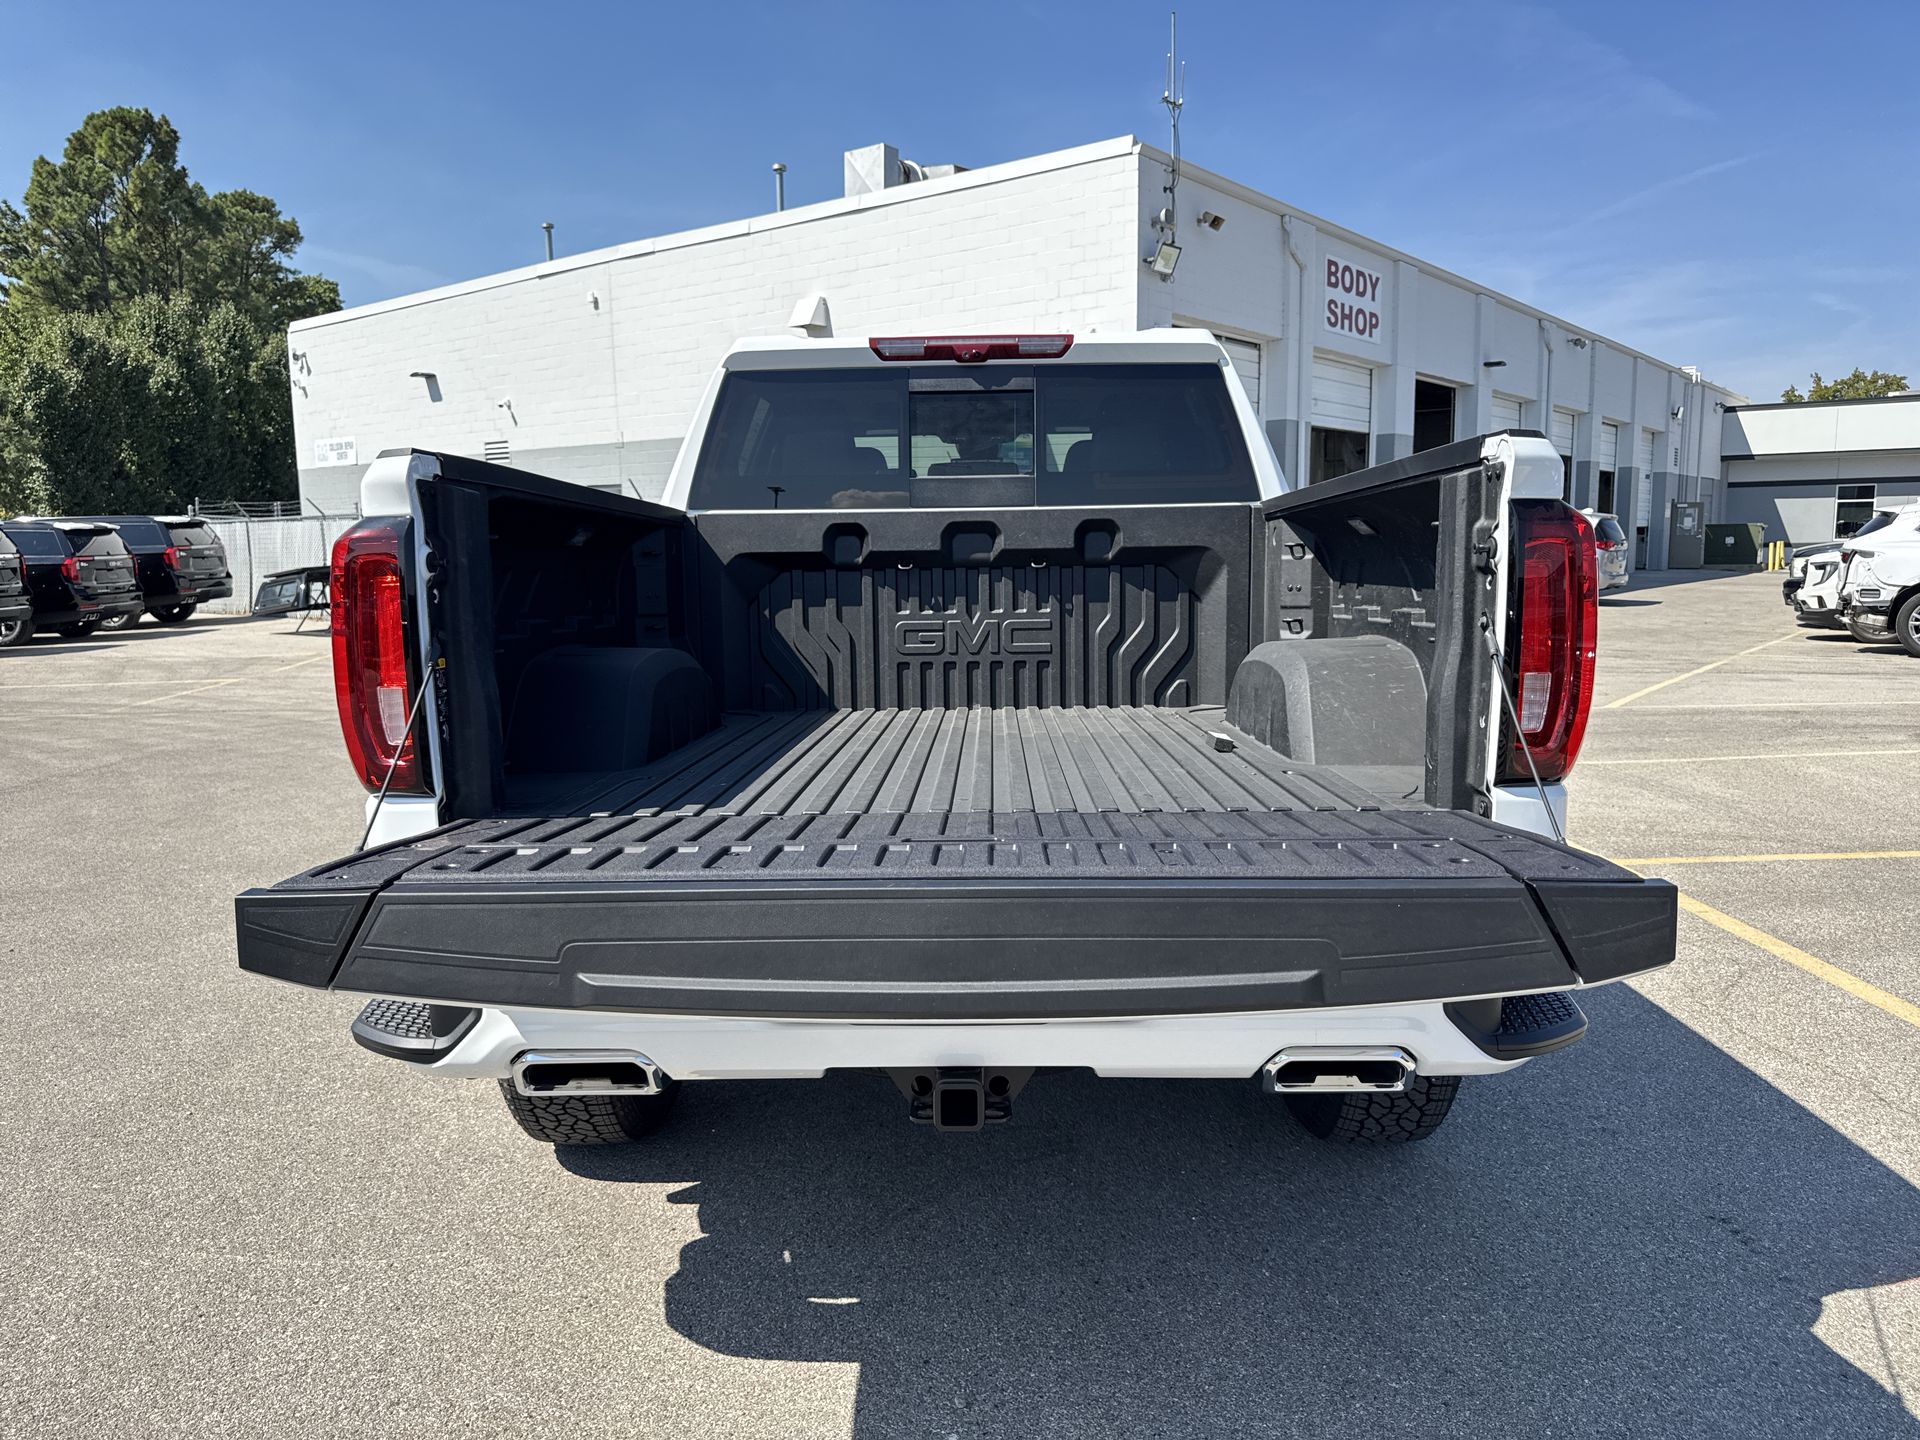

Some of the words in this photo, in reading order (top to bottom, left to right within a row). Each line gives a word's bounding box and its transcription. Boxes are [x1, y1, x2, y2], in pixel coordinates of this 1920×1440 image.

[1327, 258, 1381, 303] BODY
[1326, 298, 1380, 338] SHOP
[894, 618, 1053, 656] GMC
